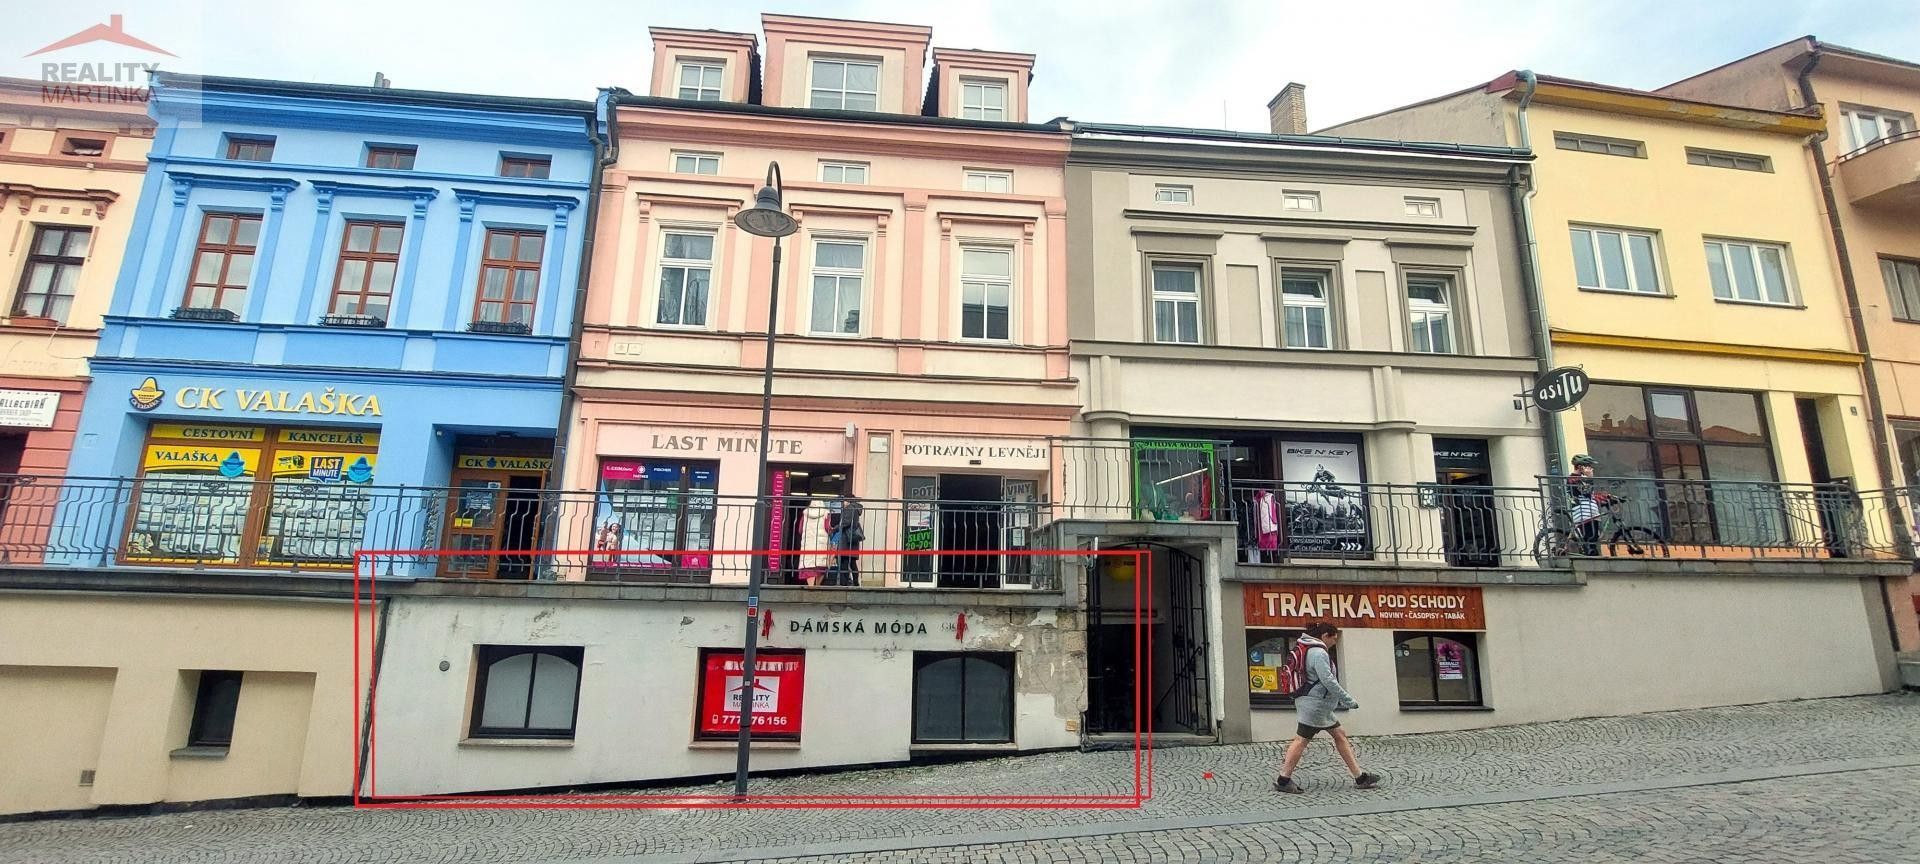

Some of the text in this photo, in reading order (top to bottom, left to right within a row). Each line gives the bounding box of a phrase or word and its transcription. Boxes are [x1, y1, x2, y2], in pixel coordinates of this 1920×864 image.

[175, 386, 383, 416] CK VALAŠKA
[182, 427, 255, 440] CESTOVNÍ
[288, 431, 365, 444] KANCELÁŘ
[651, 434, 708, 451] LAST
[155, 450, 219, 463] VALAŠKA
[904, 444, 1046, 459] POTRAVINY LEVNĚJI
[313, 458, 341, 469] LAST
[465, 458, 484, 467] CK
[312, 469, 338, 478] MINUTE
[912, 485, 936, 498] POT
[1263, 592, 1465, 619] TRAFIKA POD SCHODY
[1408, 611, 1440, 620] ČASOPISY
[1444, 611, 1466, 620] TABÁK
[790, 618, 865, 633] DÁMSKÁ
[874, 619, 928, 634] MÓDA
[767, 716, 788, 726] 156
